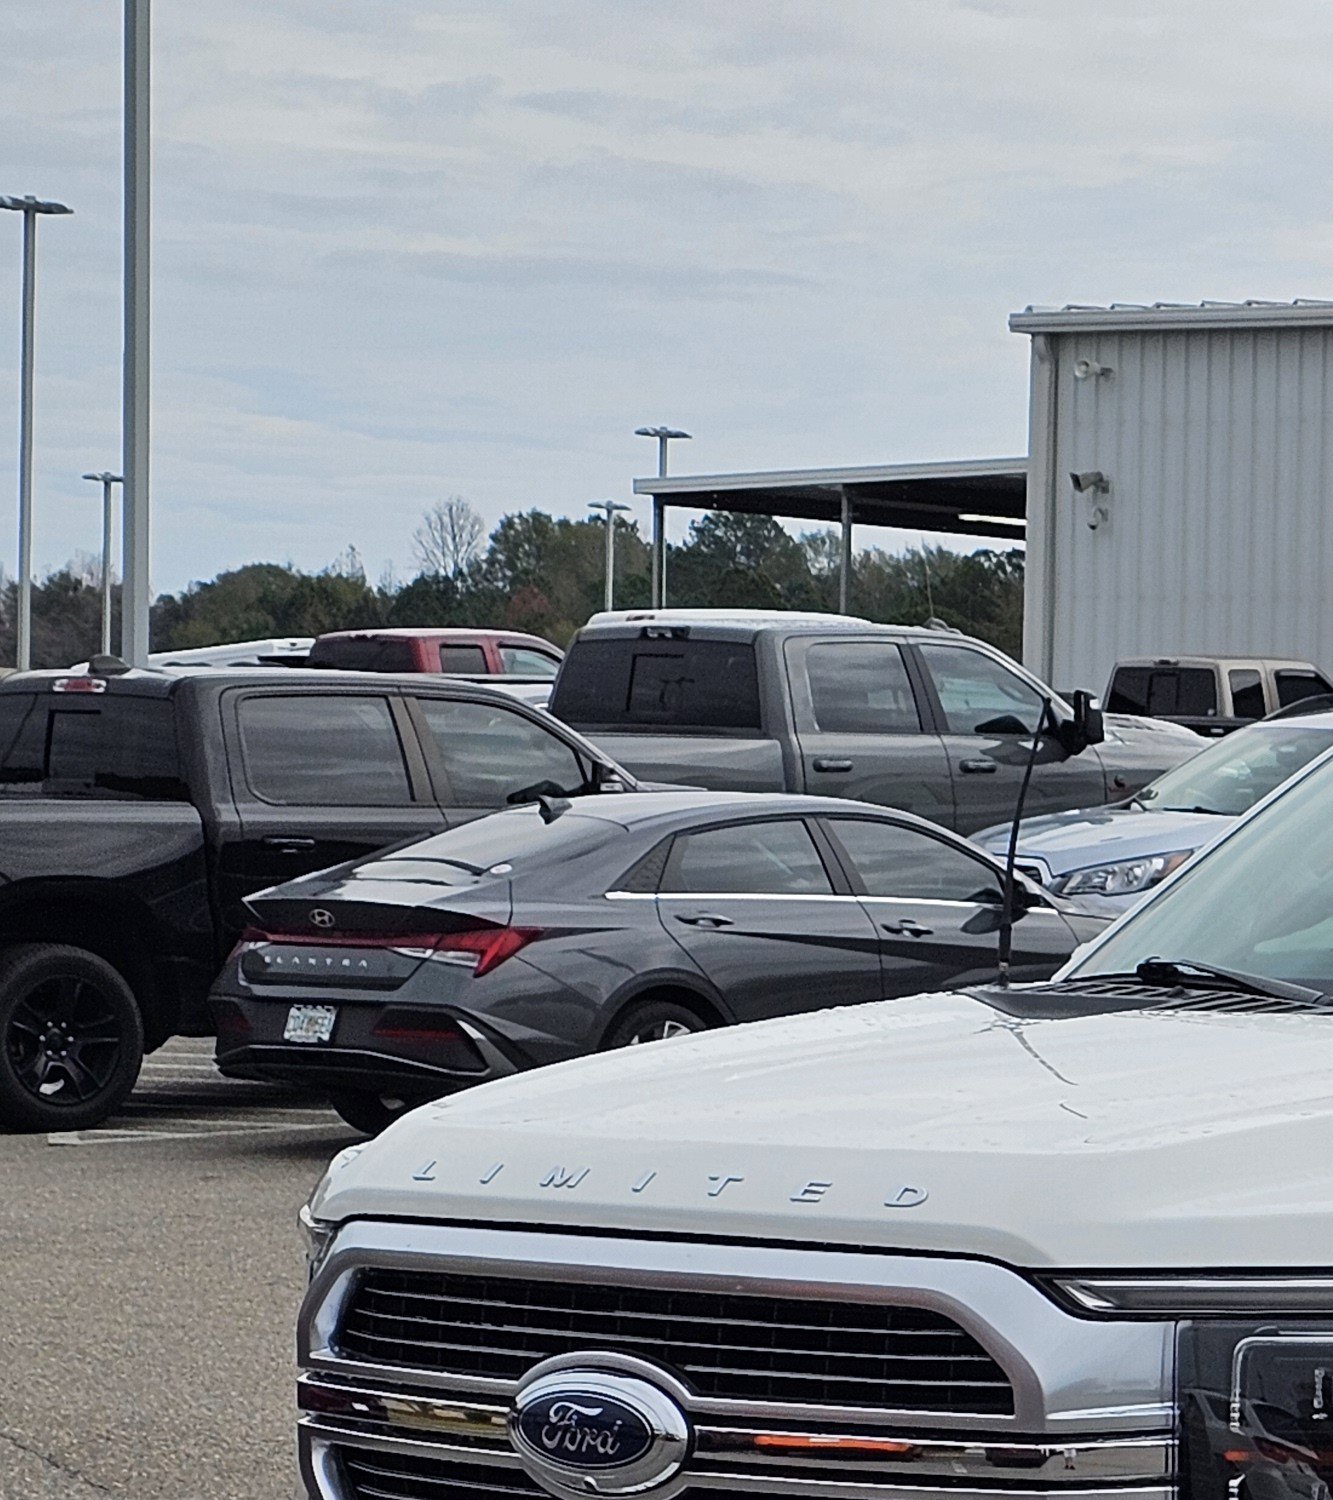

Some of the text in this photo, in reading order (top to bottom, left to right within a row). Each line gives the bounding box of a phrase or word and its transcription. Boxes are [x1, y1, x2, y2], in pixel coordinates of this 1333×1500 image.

[264, 955, 368, 969] ELANTRA
[412, 1160, 929, 1208] LIMITED
[541, 1401, 623, 1455] Ford
